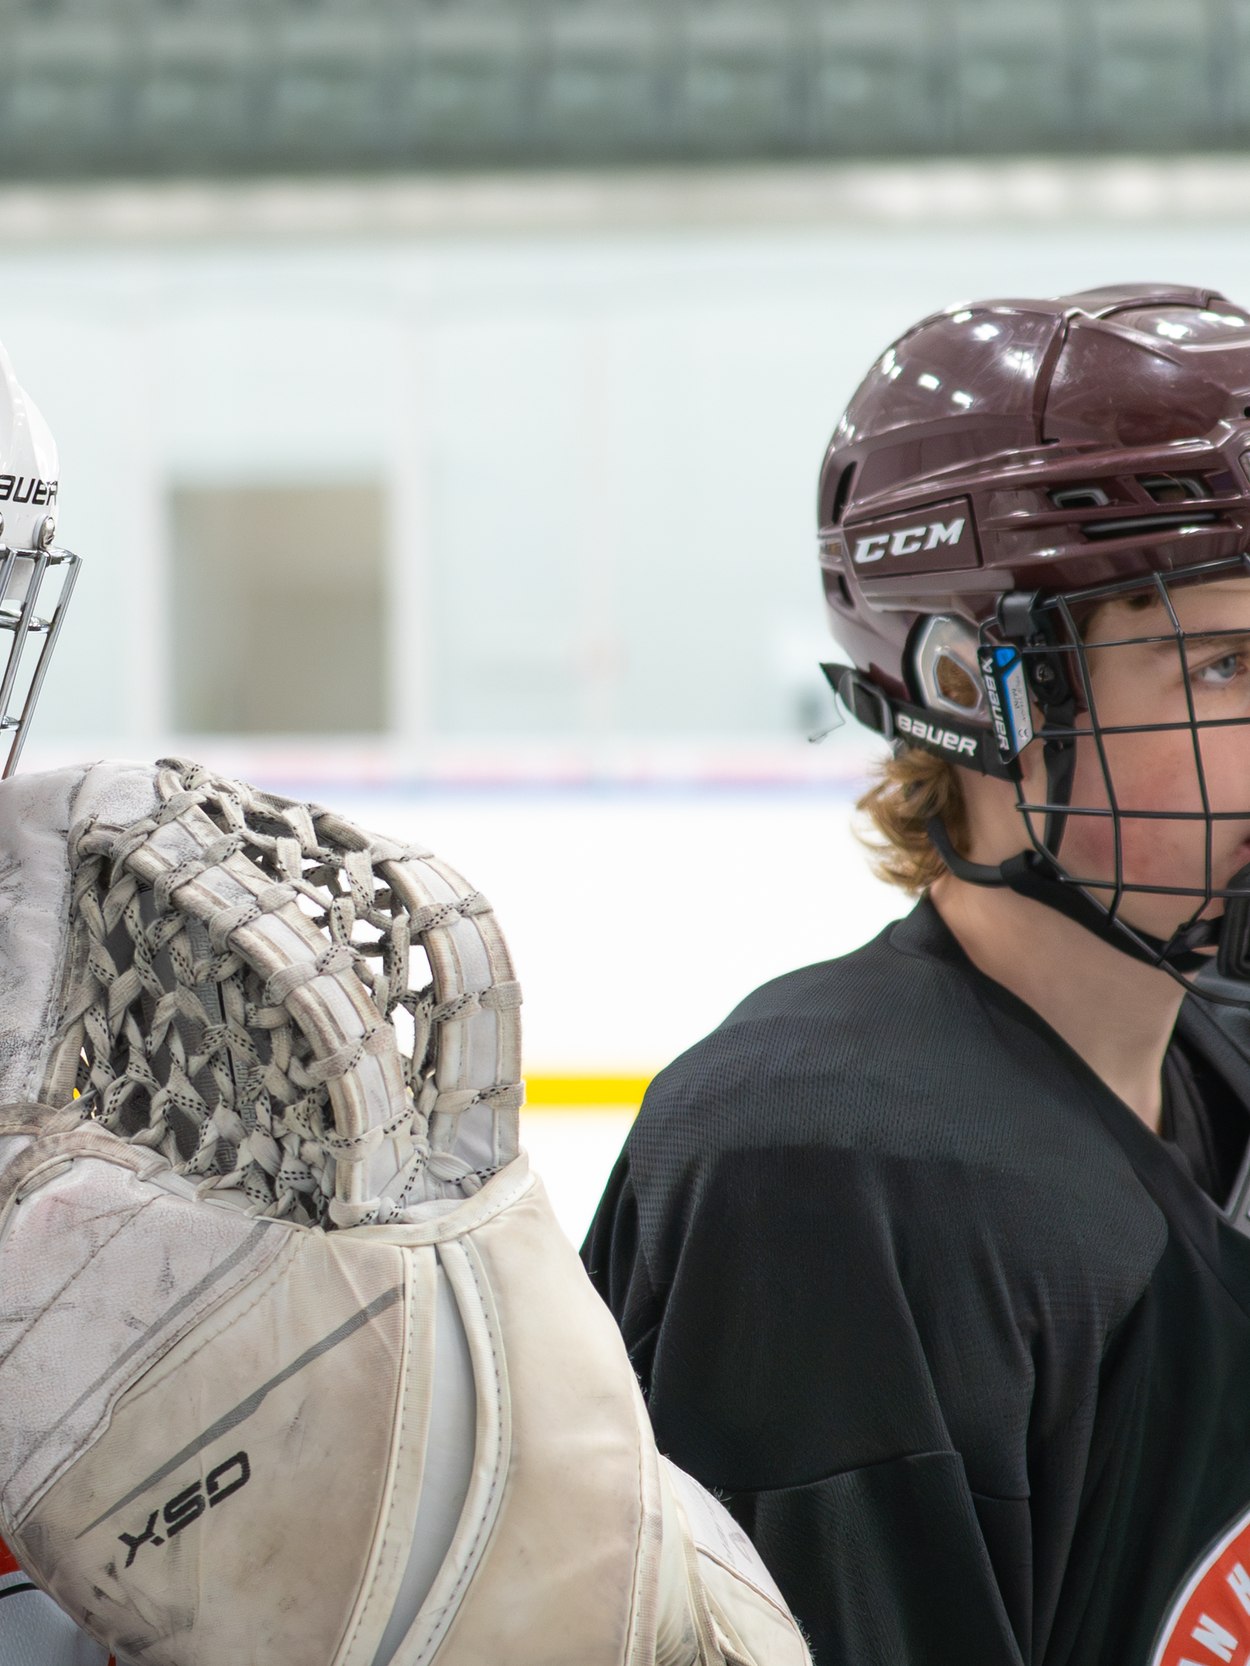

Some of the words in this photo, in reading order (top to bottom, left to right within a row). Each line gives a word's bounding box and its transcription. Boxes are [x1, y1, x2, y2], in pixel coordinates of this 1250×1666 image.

[854, 518, 966, 564] CCM
[896, 713, 978, 756] BAUER
[984, 674, 1010, 751] BAUER
[117, 1450, 251, 1569] GSX
